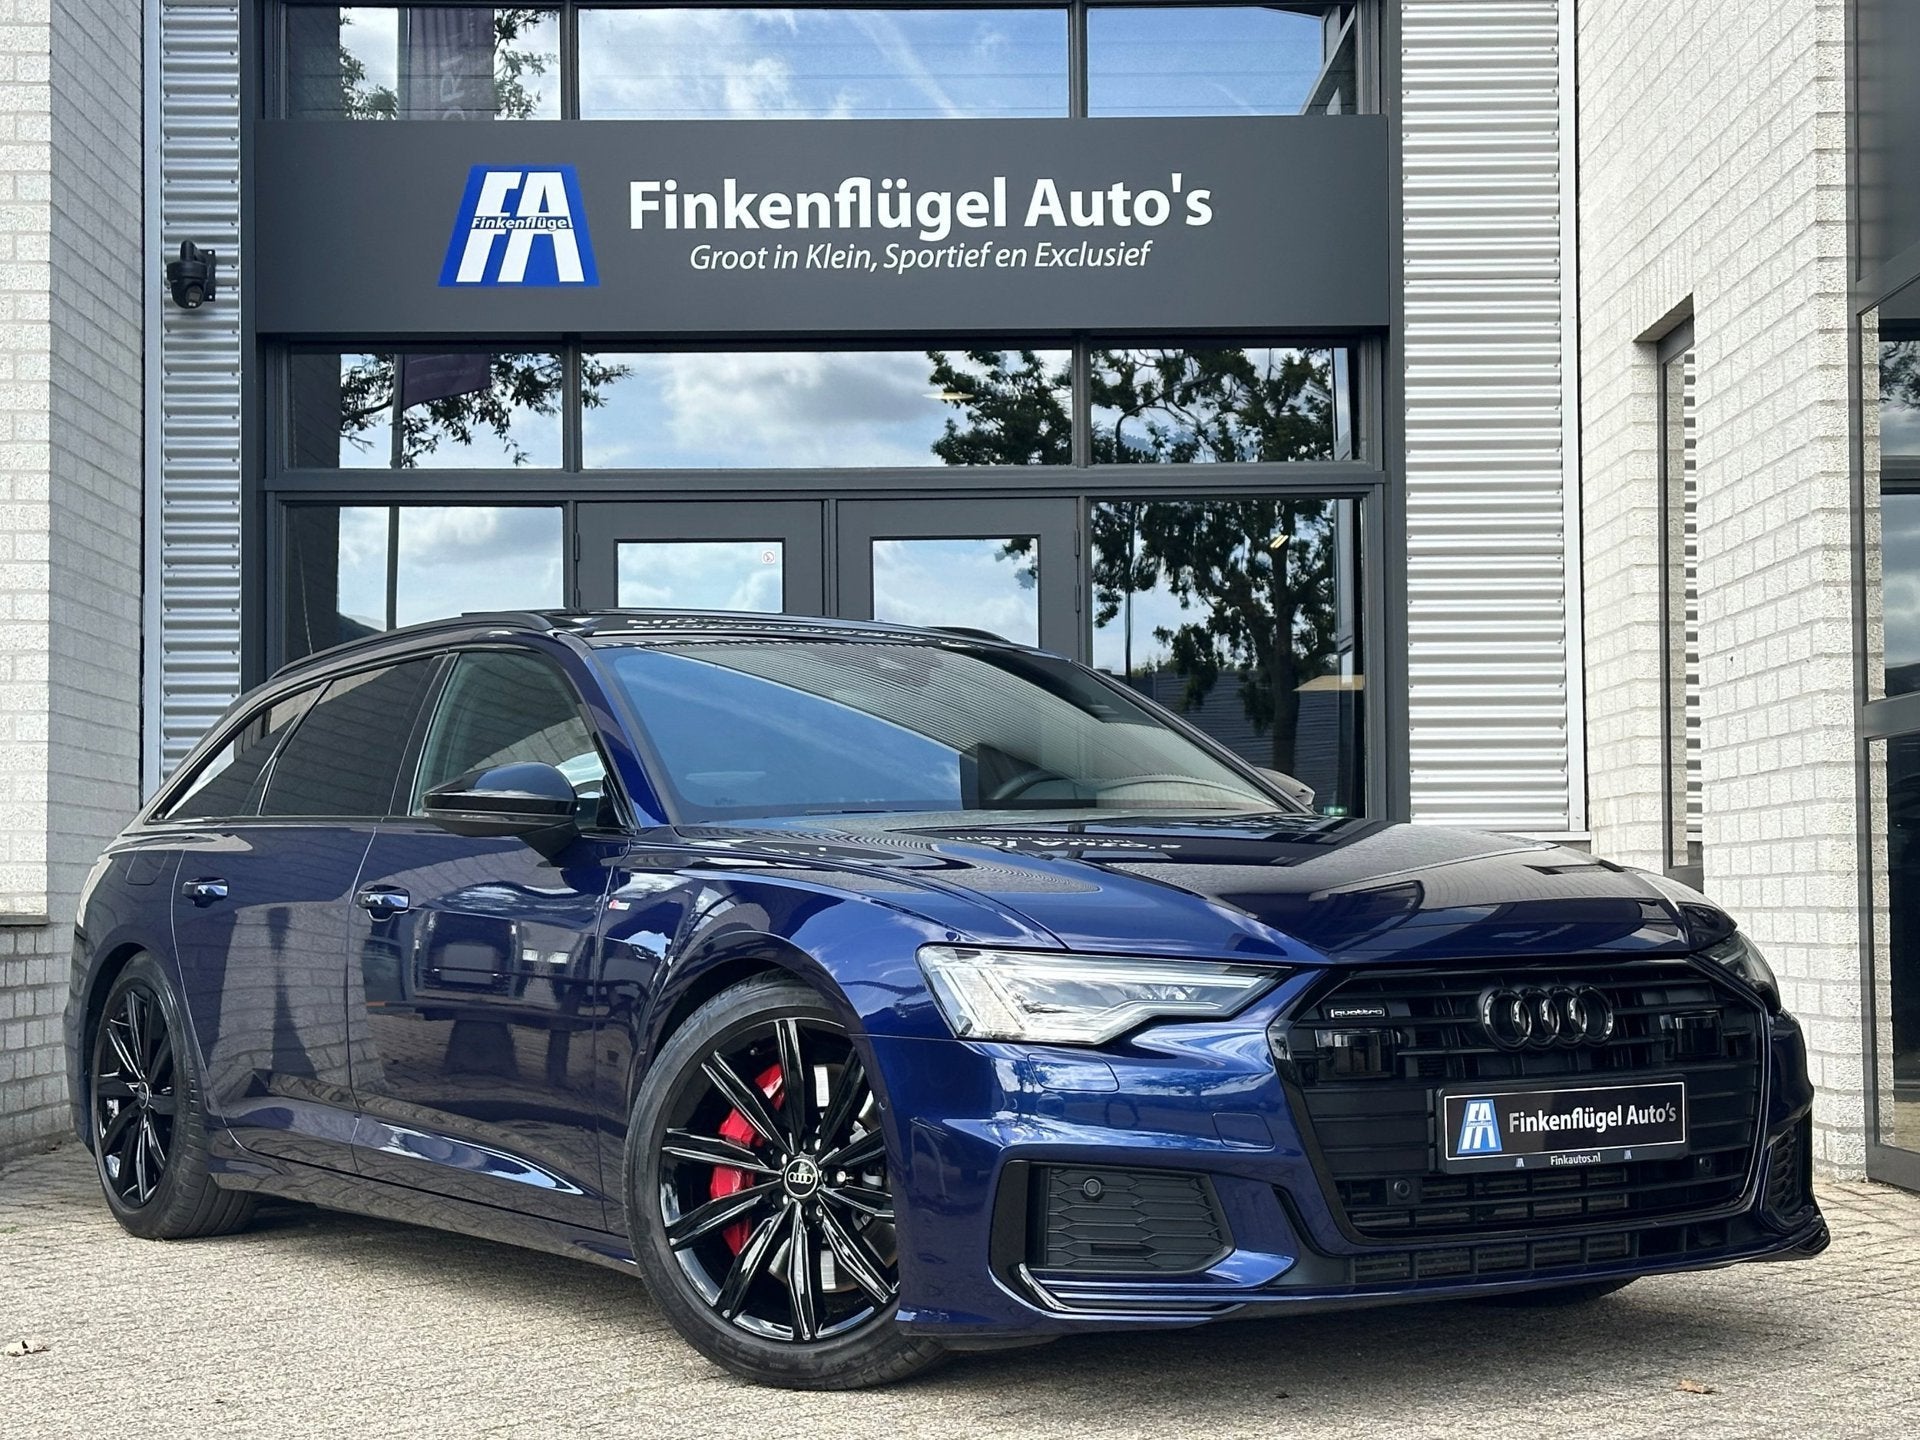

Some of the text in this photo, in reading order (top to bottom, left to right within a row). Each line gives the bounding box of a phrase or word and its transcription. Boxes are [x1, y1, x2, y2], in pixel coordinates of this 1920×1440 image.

[629, 172, 1213, 242] Finkenflügel Auto's
[471, 216, 574, 232] Finkenflügel
[689, 240, 1154, 275] Groot in Klein, Sportief en Exclusief
[1334, 1009, 1383, 1017] quattro
[1509, 1102, 1677, 1134] Finkenflügel Auto's
[1550, 1152, 1601, 1166] Finkautos.nl
